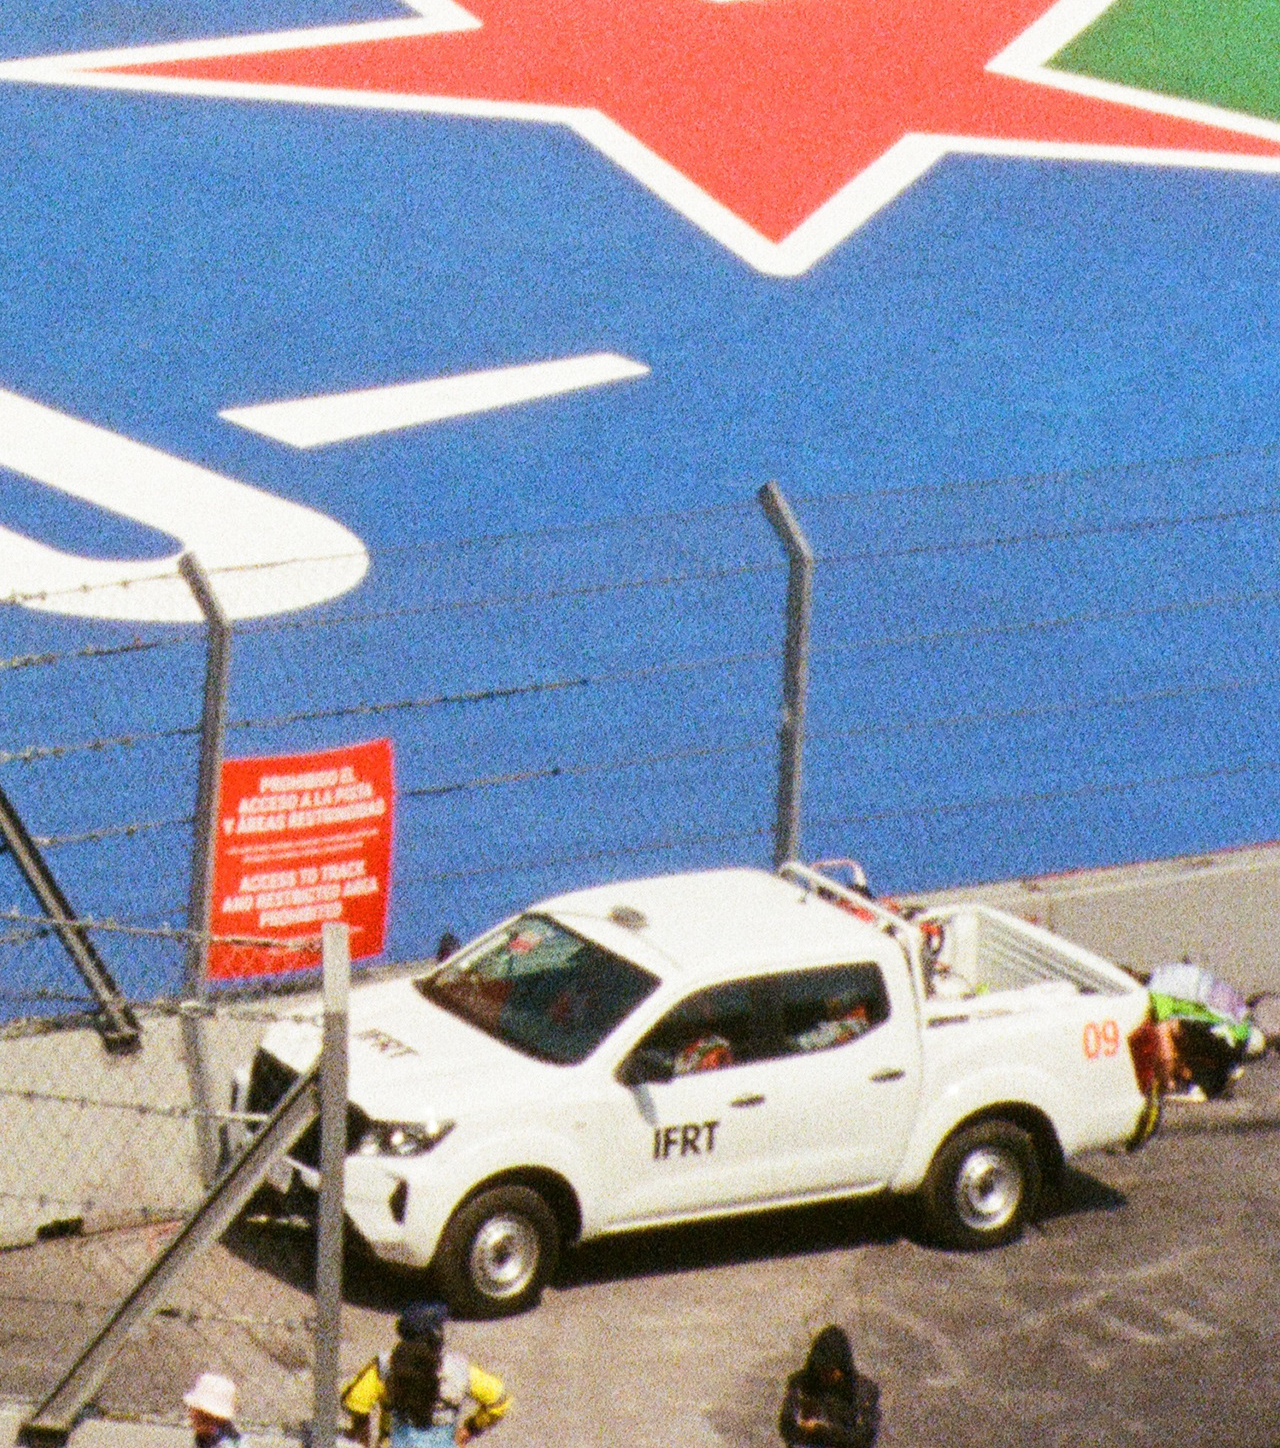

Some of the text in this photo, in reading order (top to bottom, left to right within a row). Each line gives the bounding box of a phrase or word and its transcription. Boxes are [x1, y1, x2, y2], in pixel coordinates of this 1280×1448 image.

[299, 868, 319, 885] TO
[1082, 1018, 1120, 1060] 09
[651, 1118, 721, 1161] IFRT
